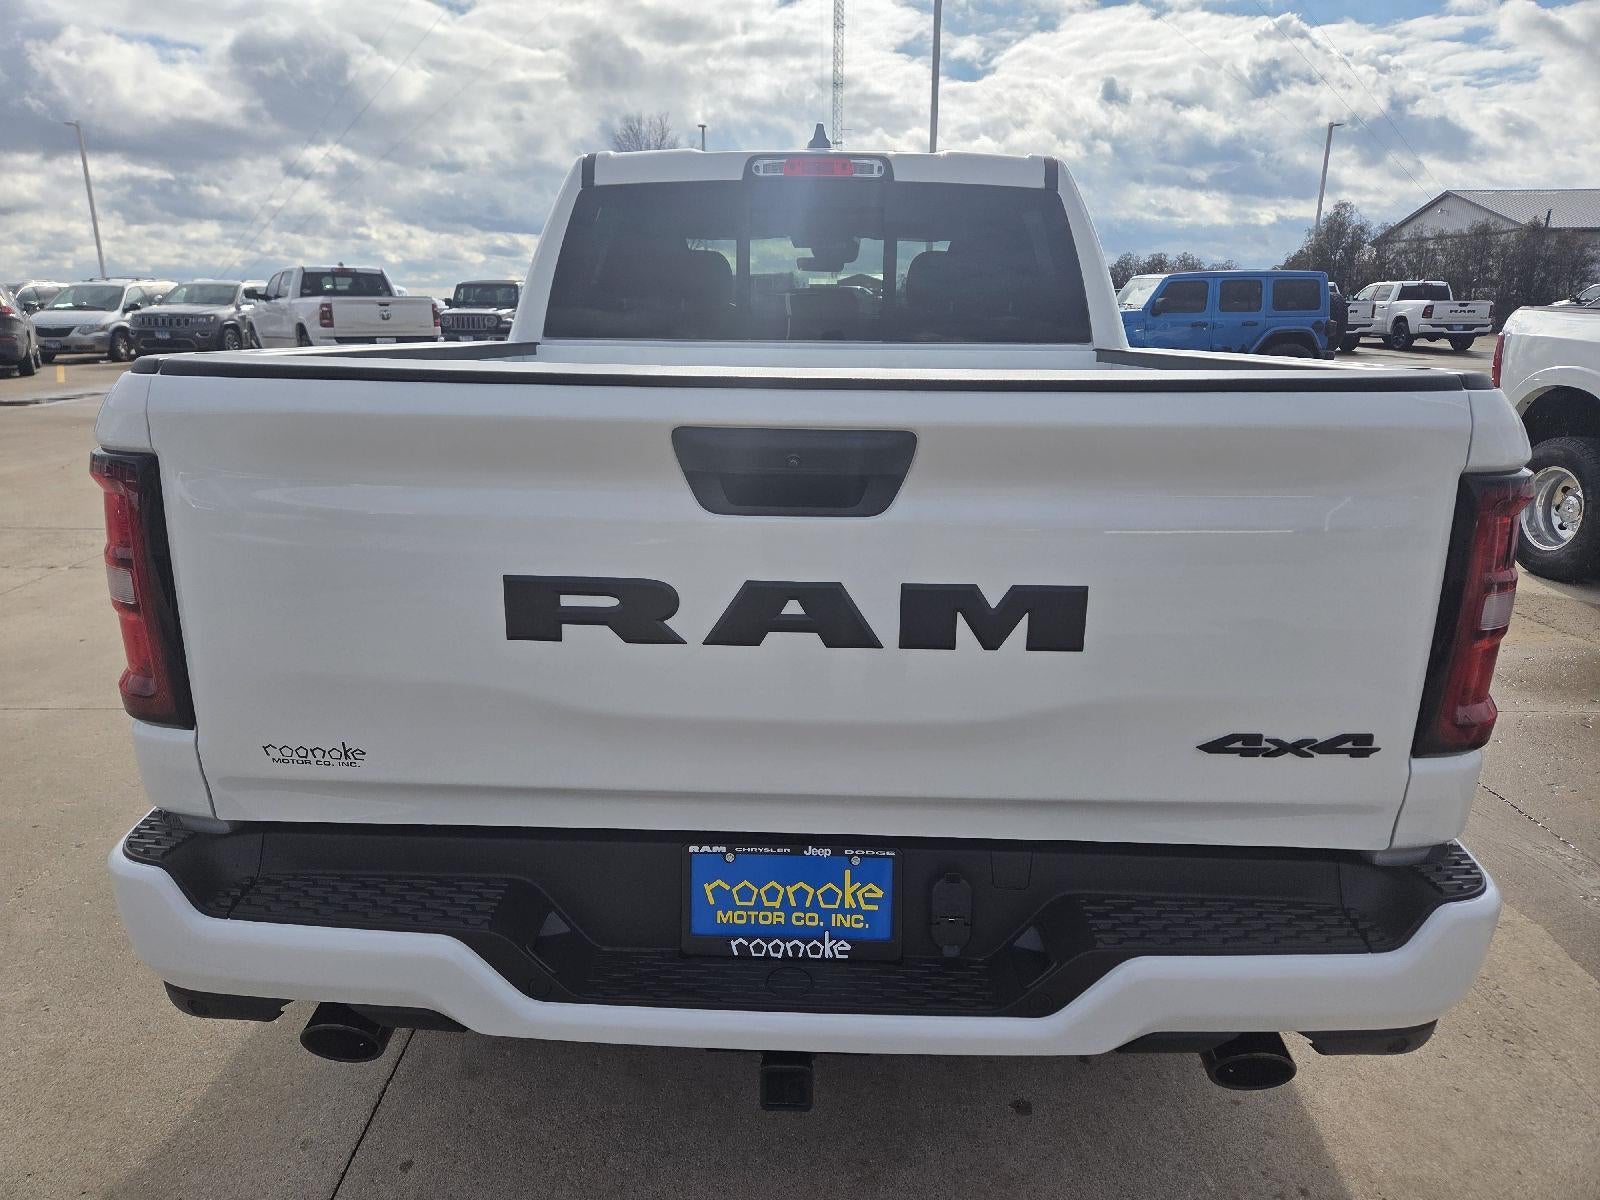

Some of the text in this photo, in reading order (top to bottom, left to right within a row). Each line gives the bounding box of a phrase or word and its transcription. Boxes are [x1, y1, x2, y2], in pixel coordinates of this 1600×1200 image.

[503, 574, 1089, 651] RAM
[262, 741, 366, 761] roanoke
[1196, 733, 1382, 758] 4x4
[688, 845, 727, 853] RAM
[803, 845, 832, 859] Jeep
[704, 869, 884, 911] roanoke
[716, 910, 869, 929] MOTOR CO. INC.
[730, 930, 851, 959] roanoke
